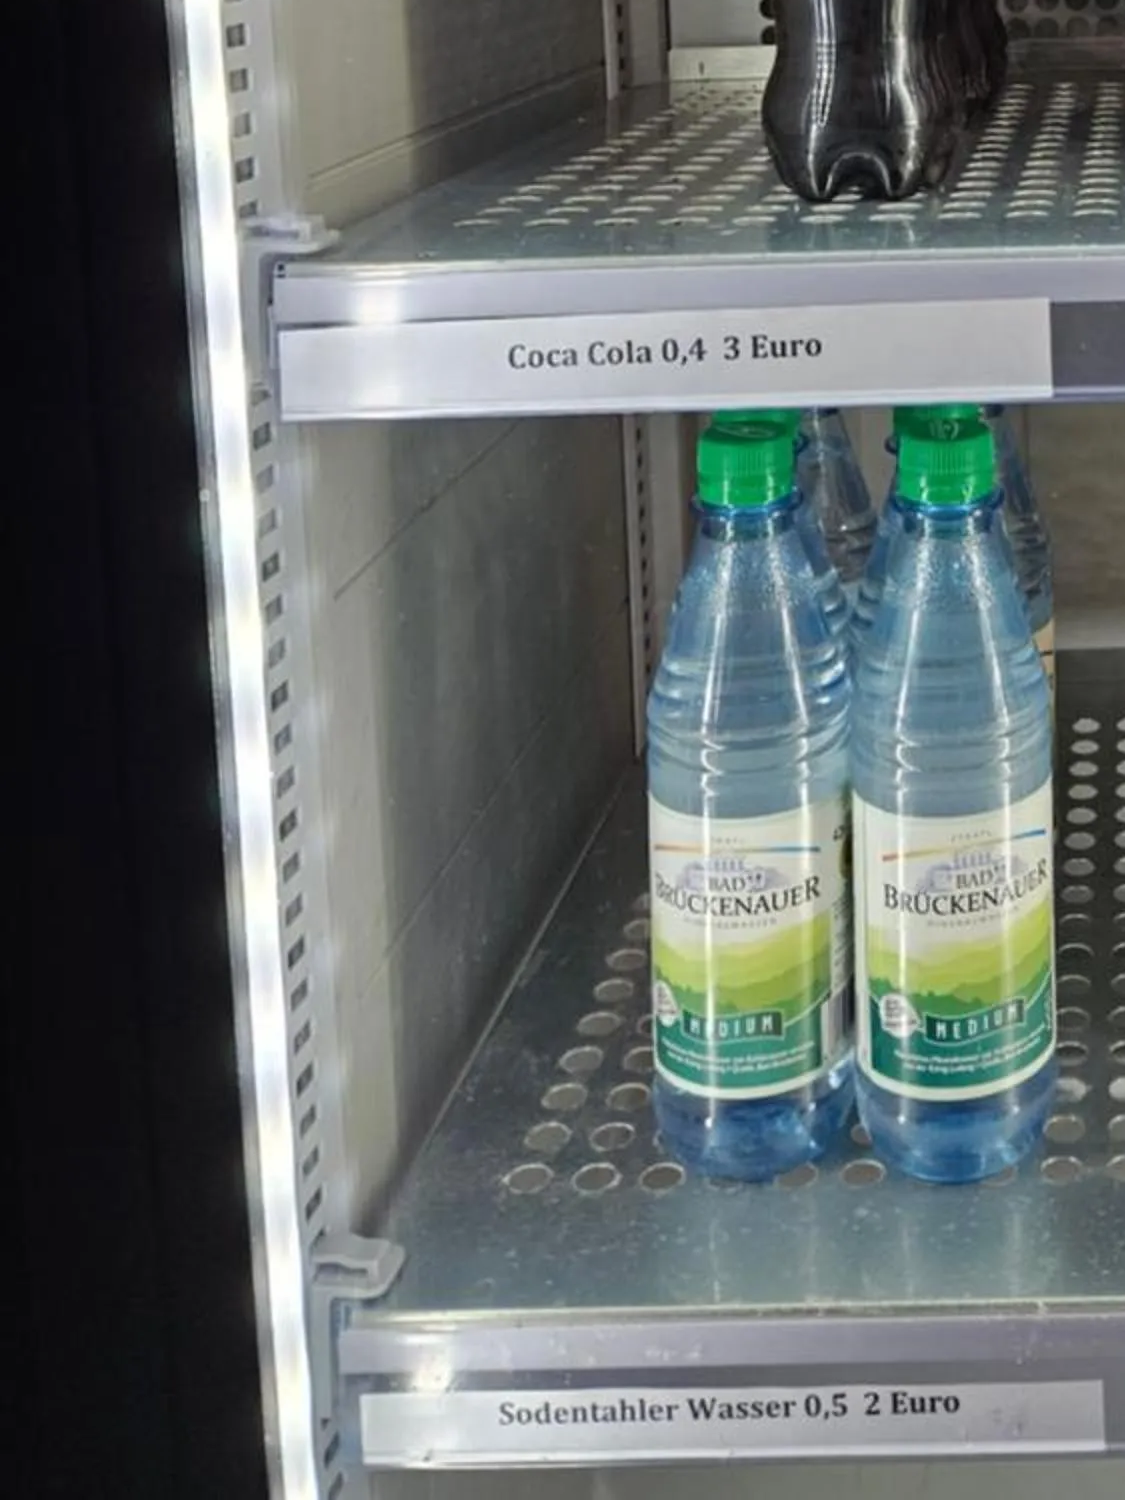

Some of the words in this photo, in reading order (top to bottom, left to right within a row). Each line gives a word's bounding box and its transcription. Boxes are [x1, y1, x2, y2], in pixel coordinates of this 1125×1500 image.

[508, 343, 578, 369] Coca
[588, 340, 652, 366] Cola
[662, 337, 707, 366] 0,4
[724, 336, 740, 360] 3
[751, 333, 822, 359] Euro
[708, 875, 746, 893] BAD
[956, 870, 994, 890] BAD
[689, 1014, 774, 1038] MDIUM
[935, 1003, 1018, 1040] MEDIUM
[499, 1398, 679, 1426] Sodentahler
[687, 1396, 797, 1422] Wasser
[803, 1395, 848, 1421] 0,5
[864, 1393, 881, 1417] 2
[890, 1391, 960, 1415] Euro
